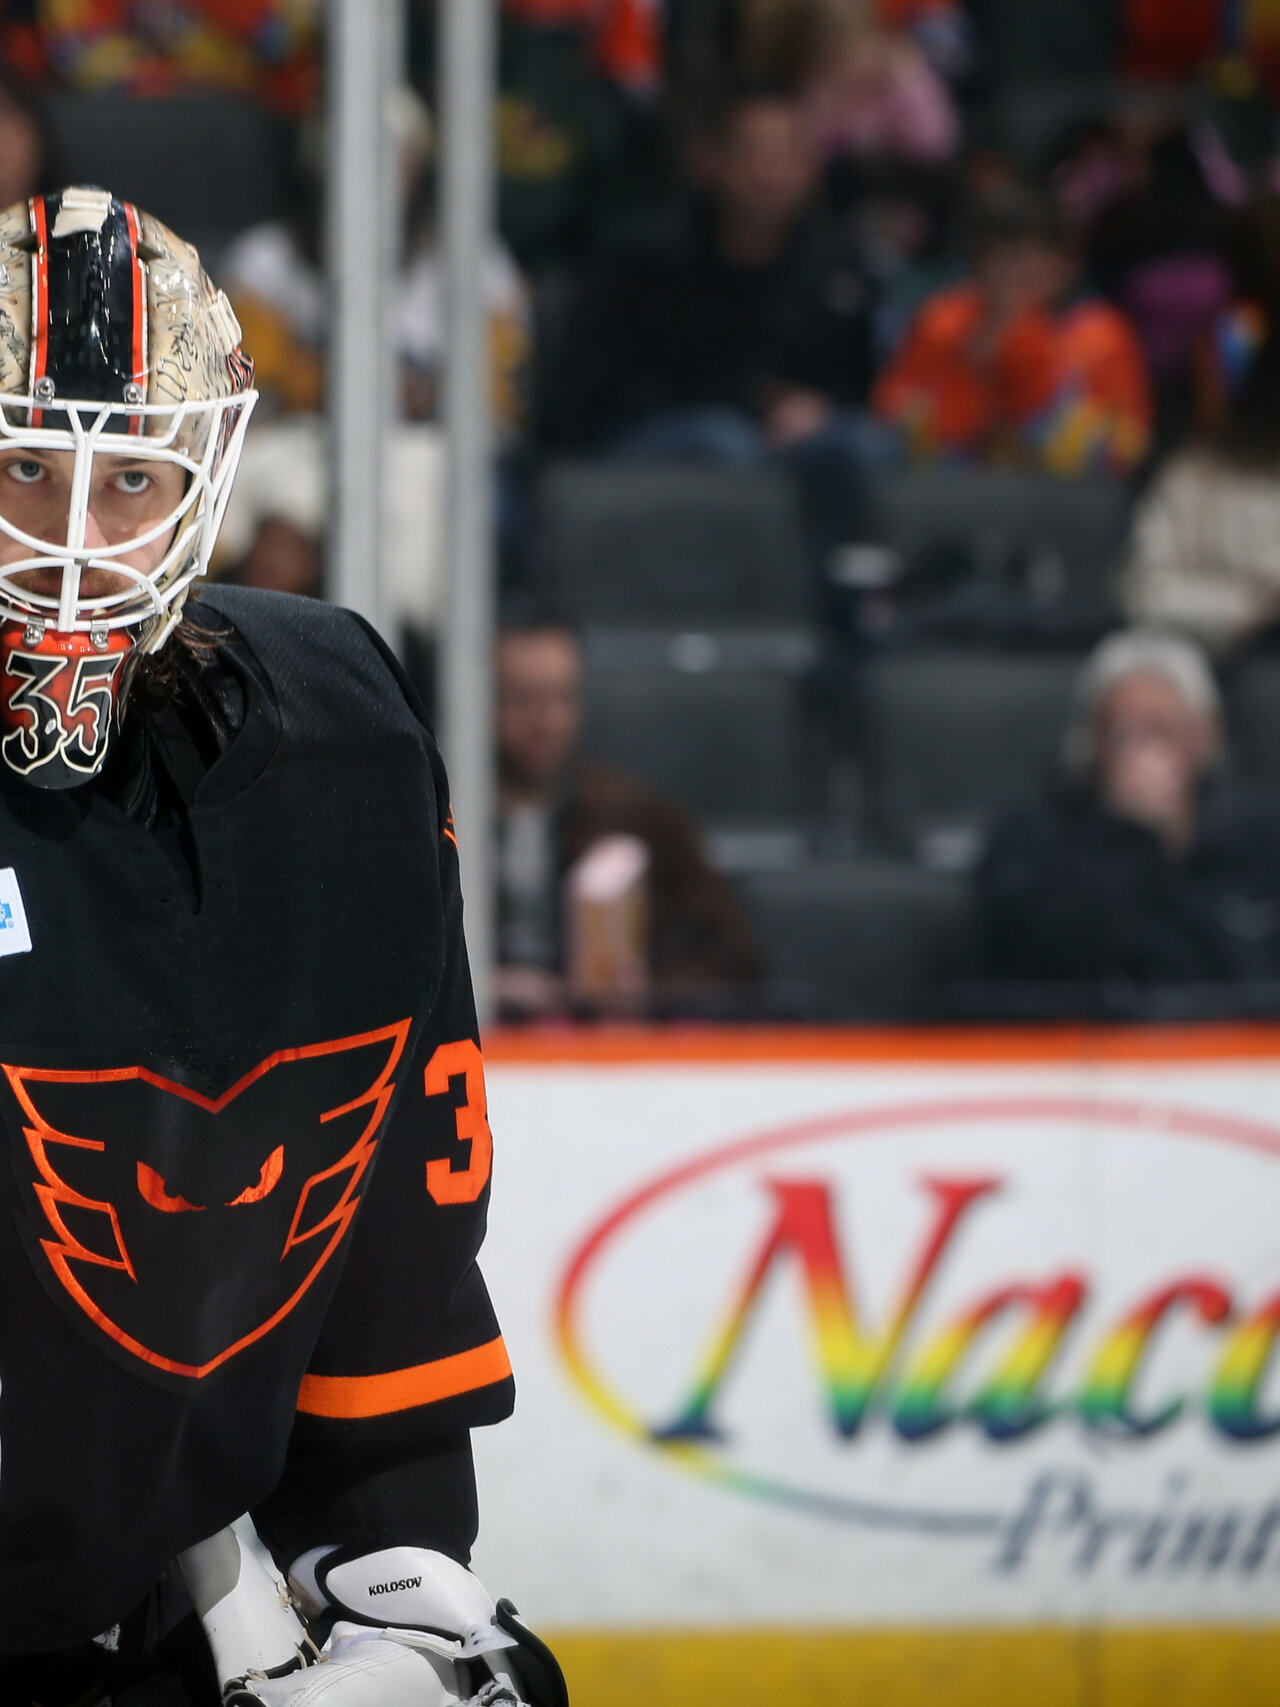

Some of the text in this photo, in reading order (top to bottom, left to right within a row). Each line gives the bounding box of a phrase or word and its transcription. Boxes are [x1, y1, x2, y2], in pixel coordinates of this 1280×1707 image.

[1, 650, 125, 776] 35
[423, 1038, 493, 1206] 3
[368, 1576, 423, 1597] KOLOSOV
